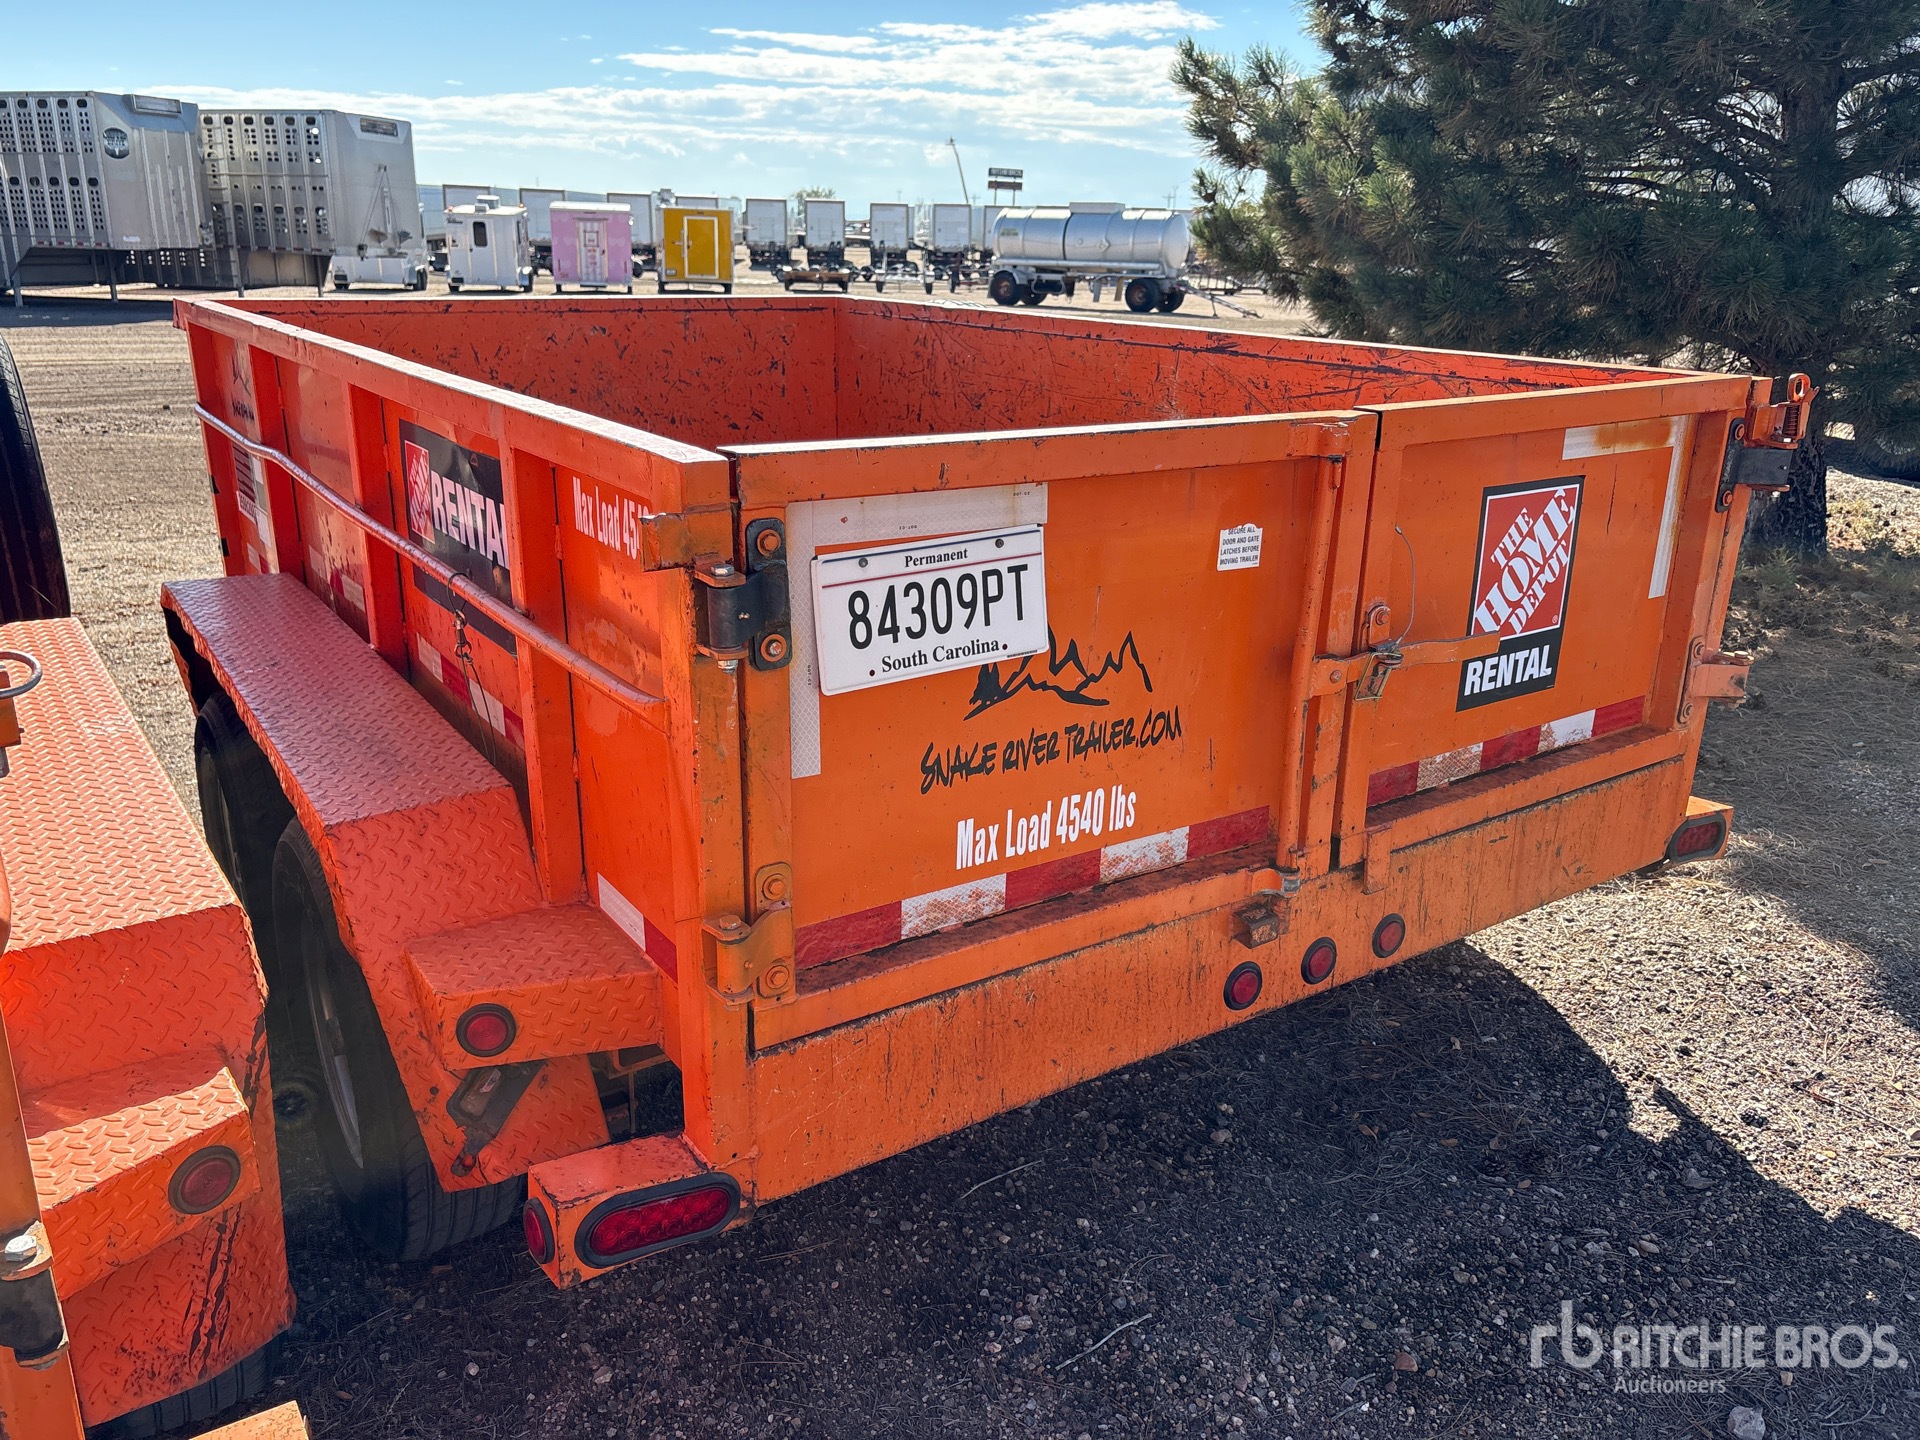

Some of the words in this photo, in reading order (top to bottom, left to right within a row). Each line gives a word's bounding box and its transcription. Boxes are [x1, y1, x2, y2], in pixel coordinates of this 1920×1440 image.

[572, 476, 595, 539] Max
[595, 485, 621, 552] Load
[1222, 538, 1236, 546] DOOR
[1237, 536, 1246, 544] AND
[1248, 535, 1259, 543] GATE
[1228, 527, 1246, 535] SECURE
[1490, 506, 1534, 570] THE
[904, 548, 968, 568] Permanent
[1220, 556, 1238, 565] MOVING
[1221, 547, 1241, 555] LATCHES
[1242, 545, 1259, 553] BEFORE
[1474, 487, 1575, 633] HOME
[848, 563, 1028, 650] 84309PT
[1508, 540, 1570, 635] DEPOT
[881, 649, 929, 673] South
[932, 638, 1000, 663] Carolina
[1463, 644, 1553, 697] RENTAL
[920, 741, 998, 795] SNAKE
[1002, 727, 1060, 774] RIVER
[955, 817, 1000, 871] Max
[1005, 799, 1052, 859] Load
[1055, 787, 1105, 844] 4540
[1108, 783, 1137, 832] lbs
